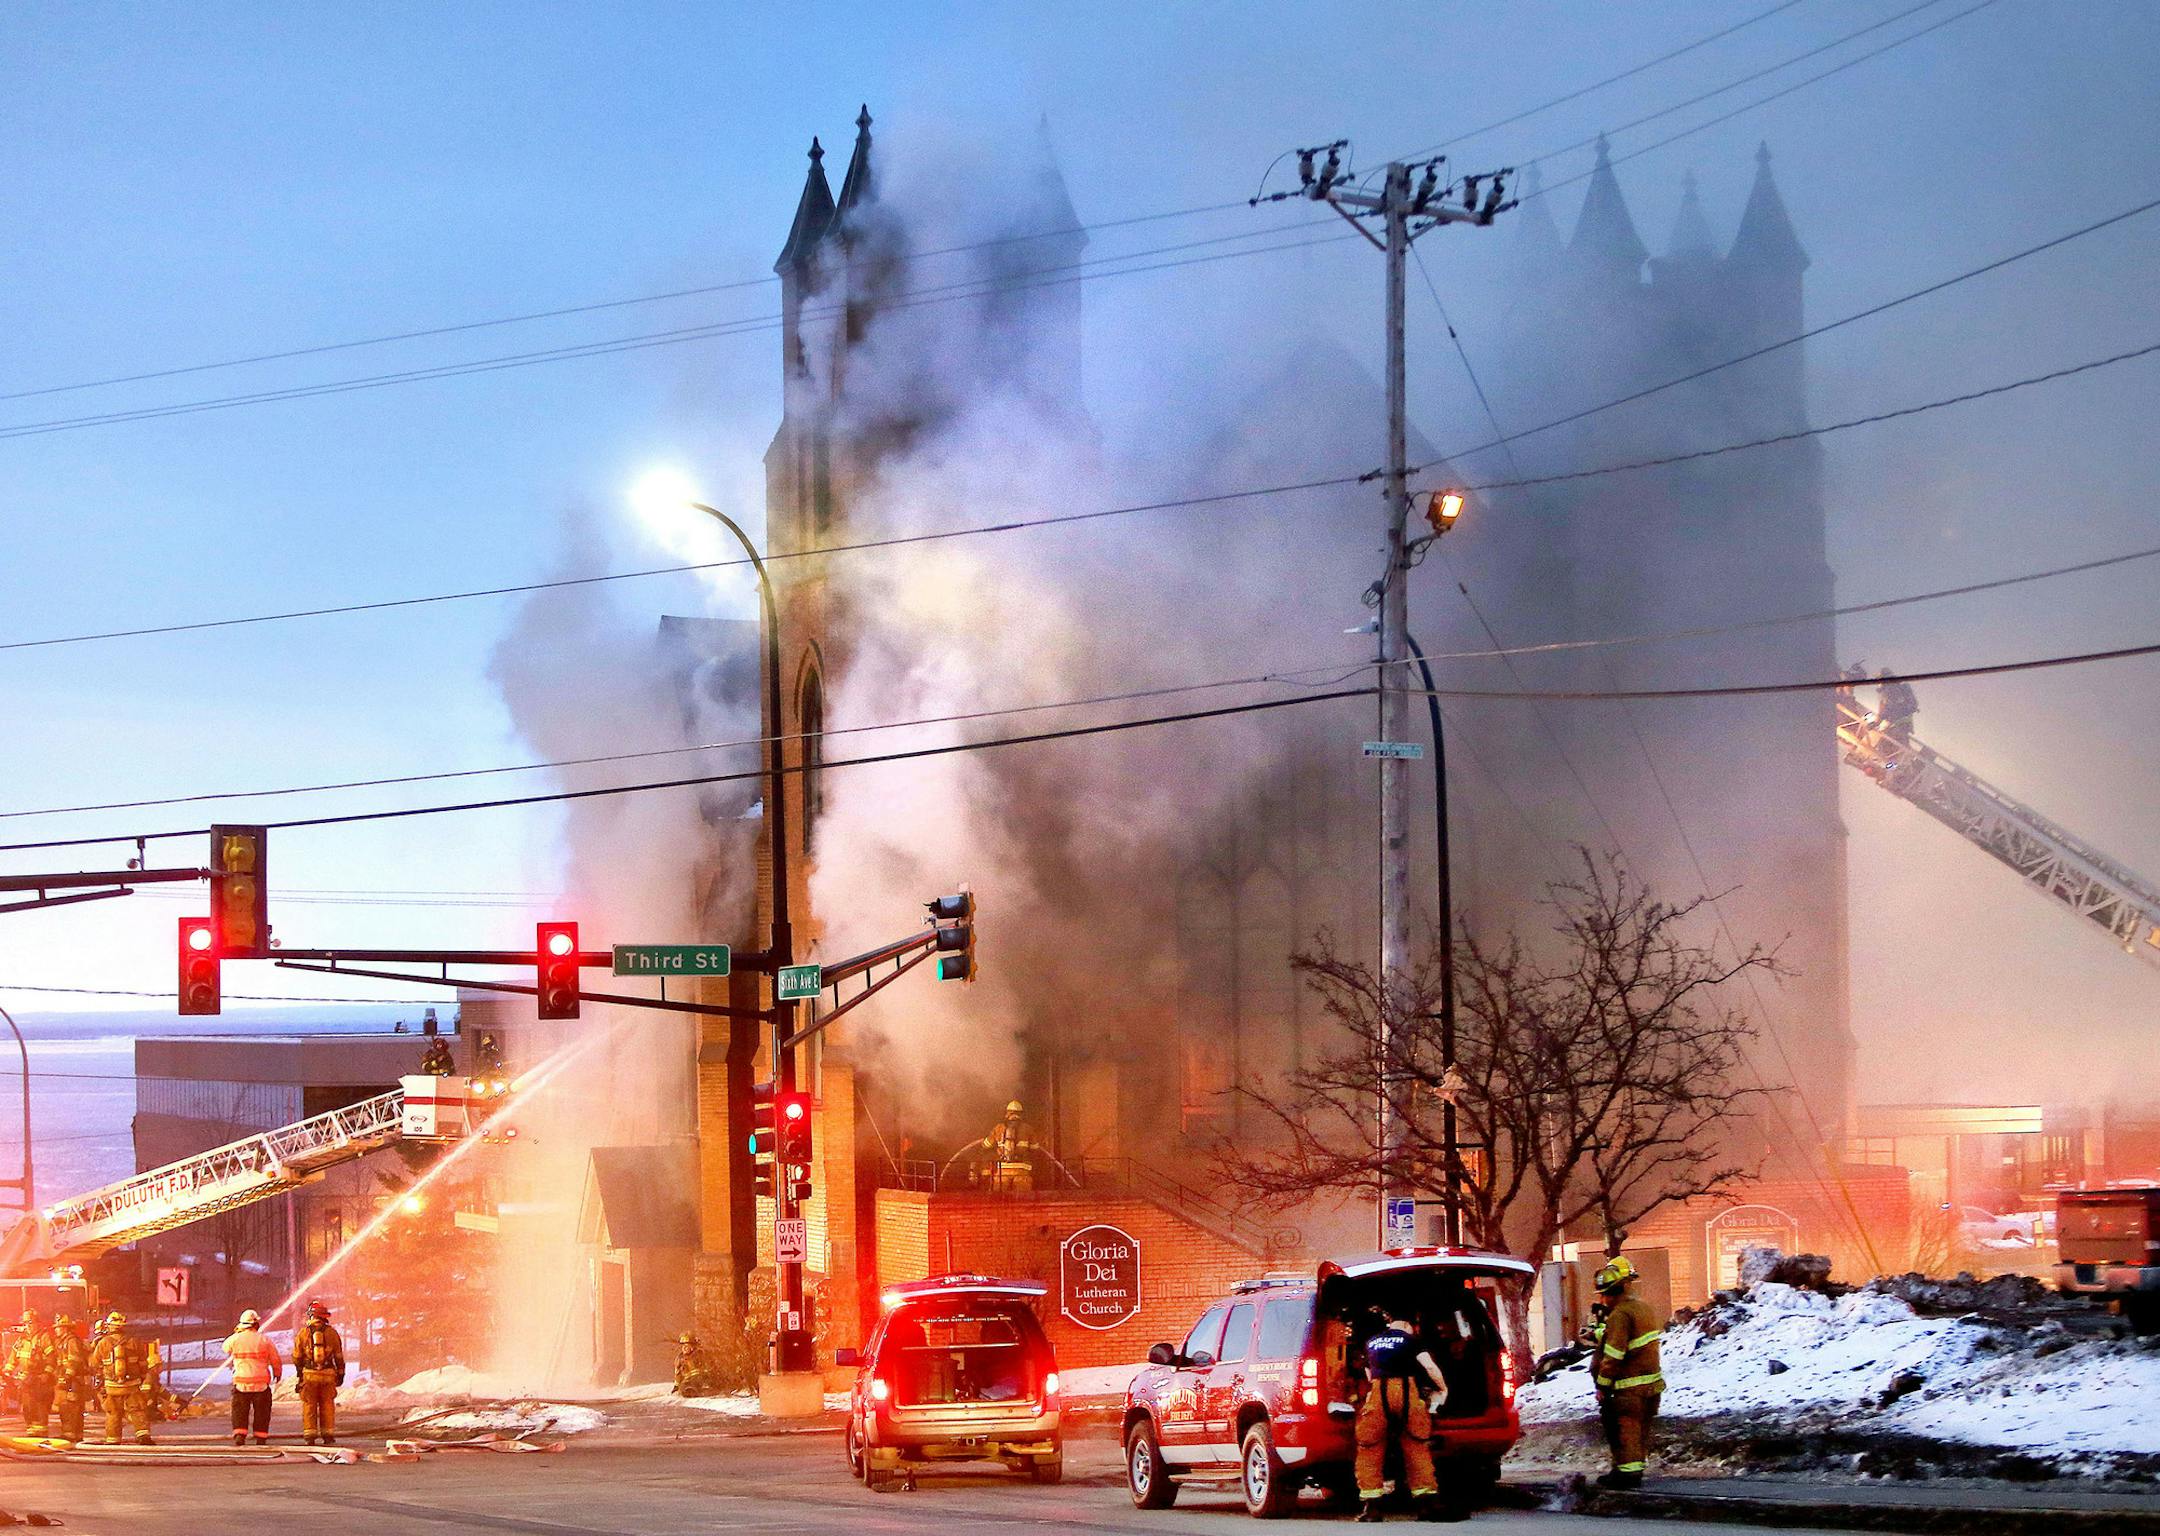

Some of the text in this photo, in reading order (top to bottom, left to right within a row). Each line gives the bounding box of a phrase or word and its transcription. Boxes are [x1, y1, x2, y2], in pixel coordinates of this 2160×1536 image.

[625, 952, 718, 969] Third St
[781, 971, 819, 992] Sixth Ave E
[115, 1174, 191, 1211] DULUTH F.D.
[779, 1222, 803, 1234] ONE
[1721, 1214, 1757, 1228] Gloria
[779, 1234, 803, 1246] WAY
[1070, 1241, 1130, 1261] Gloria
[1084, 1263, 1118, 1282] Dei
[1075, 1286, 1127, 1298] Lutheran
[1079, 1301, 1124, 1315] Church
